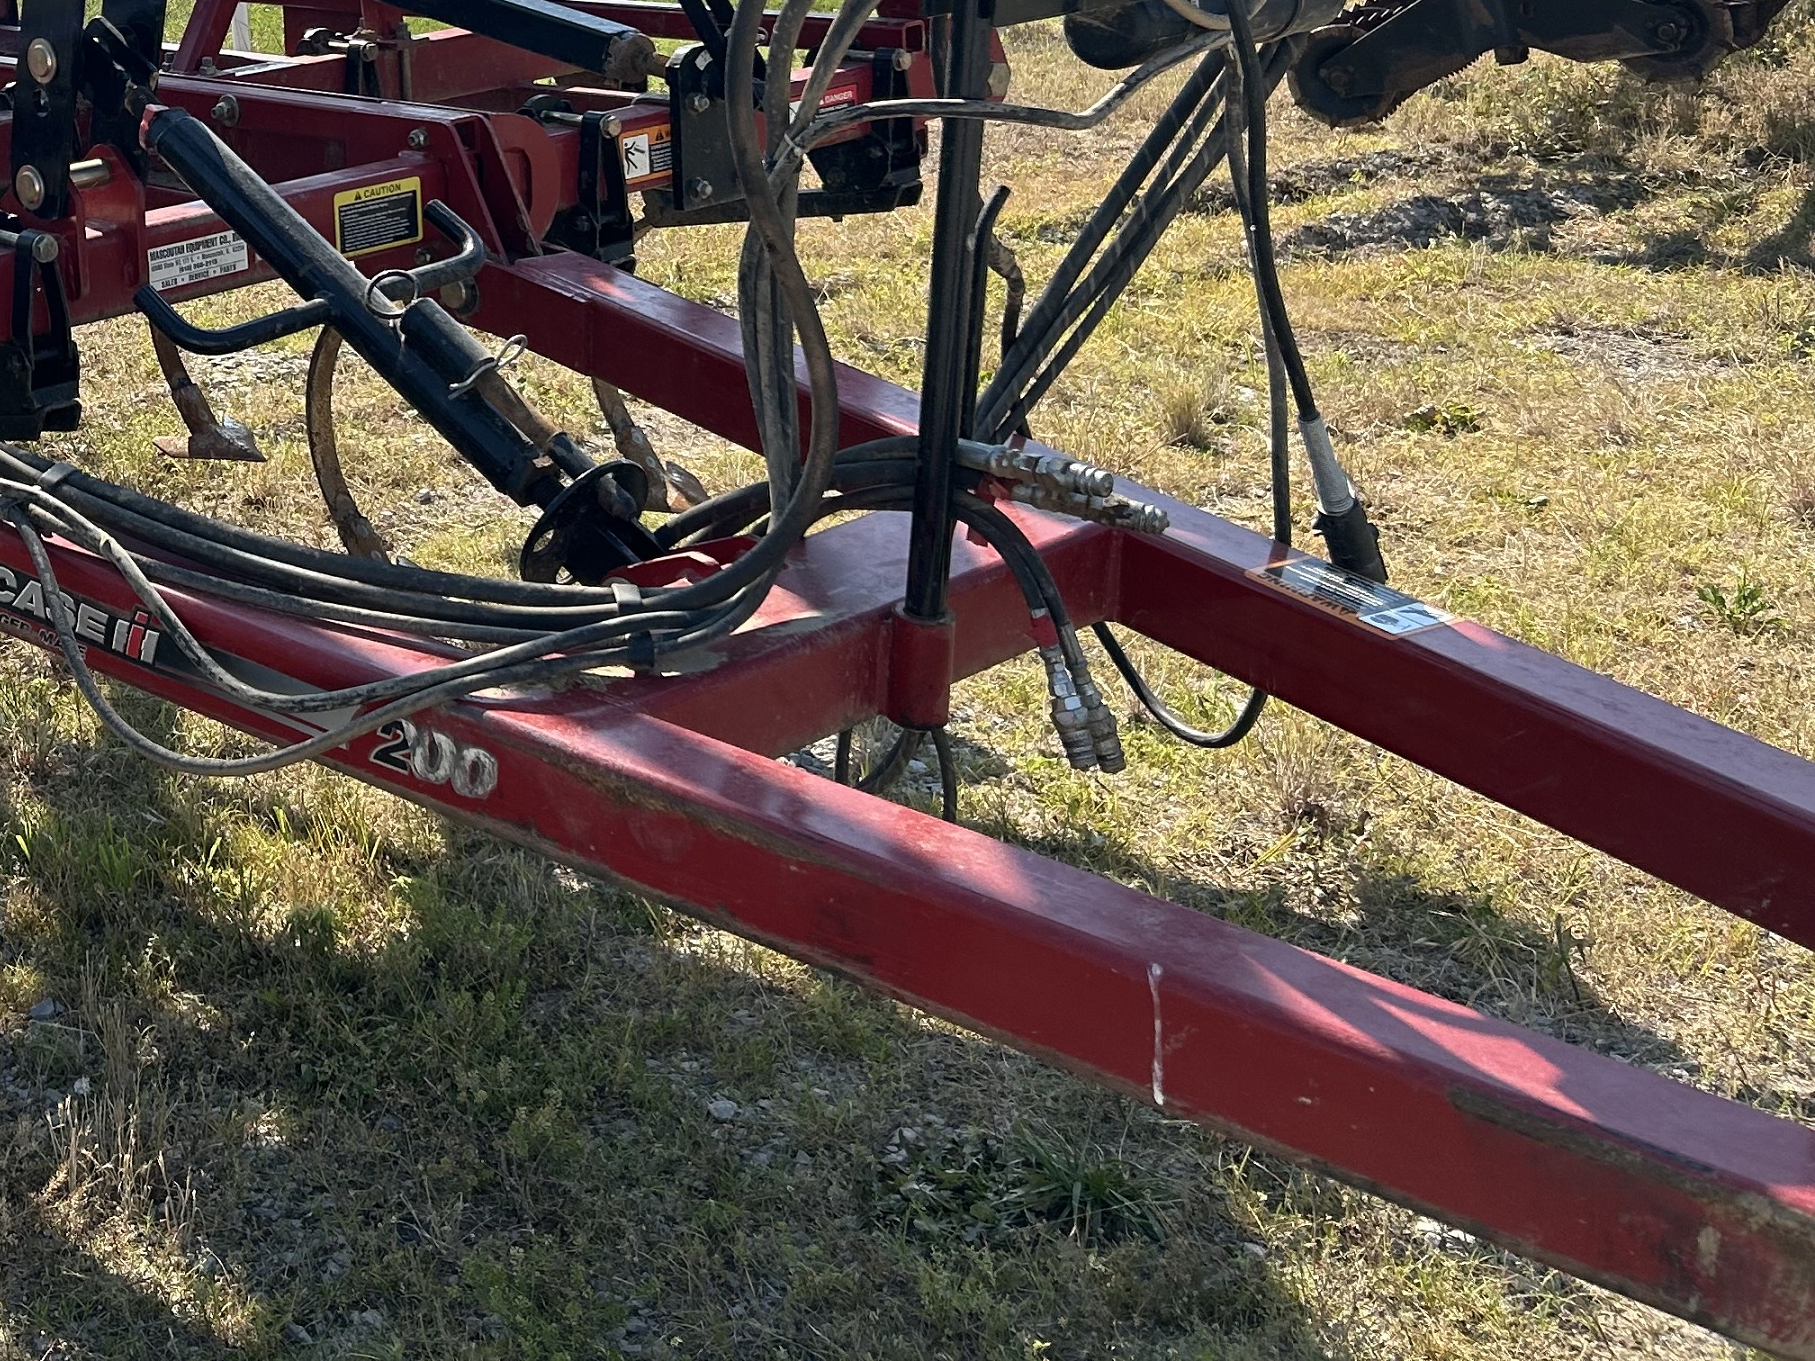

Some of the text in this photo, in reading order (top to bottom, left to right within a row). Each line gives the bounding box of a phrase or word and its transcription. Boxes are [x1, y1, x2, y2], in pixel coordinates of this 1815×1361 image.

[824, 90, 853, 103] DANGER
[363, 183, 401, 198] CAUTION
[149, 244, 185, 261] MASCOUTAH
[185, 236, 219, 253] EQUIPMENT
[161, 263, 237, 288] SALES SERVICE PARTS
[37, 628, 87, 660] ME
[370, 719, 499, 799] 200
